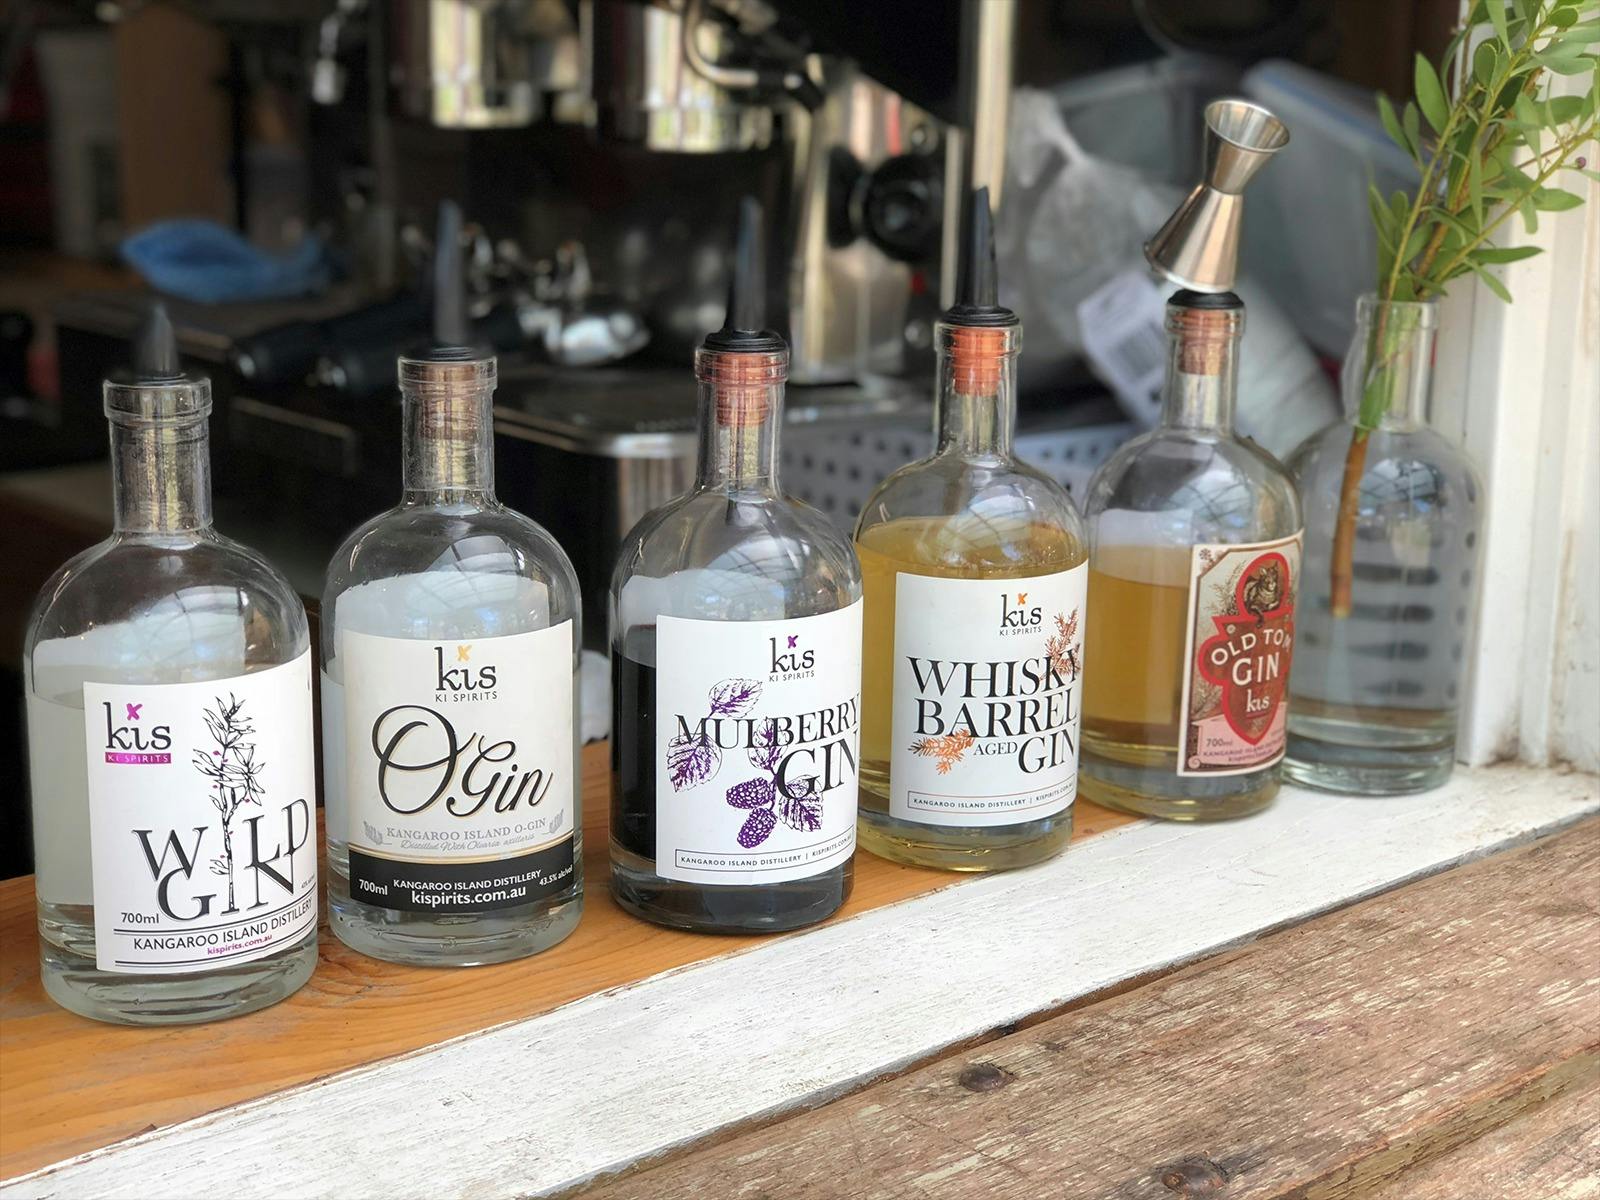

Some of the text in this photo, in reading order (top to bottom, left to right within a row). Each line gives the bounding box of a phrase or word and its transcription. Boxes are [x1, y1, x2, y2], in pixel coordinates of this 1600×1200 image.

[1001, 592, 1042, 628] kis
[1012, 626, 1042, 635] SPIRITS
[769, 635, 815, 673] kis
[1211, 633, 1257, 665] OLD
[434, 645, 497, 691] kis
[783, 671, 815, 682] SPIRITS
[906, 643, 1080, 698] WHISKY
[1232, 652, 1280, 686] GIN
[435, 691, 498, 702] KI SPIRITS
[914, 687, 1077, 738] BARREL
[1246, 689, 1270, 712] kis
[102, 701, 172, 751] kis
[674, 692, 860, 750] MULBERRY
[124, 754, 169, 763] SPIRITS
[973, 722, 1077, 774] AGED GIN
[776, 728, 859, 801] GIN
[914, 798, 956, 808] KANGAROO
[958, 799, 985, 808] ISLAND
[988, 798, 1026, 808] DISTILLERY
[387, 818, 546, 841] KANGAROO ISLAND O-GIN
[680, 856, 726, 867] KANGAROO
[728, 857, 758, 867] ISLAND
[760, 855, 802, 866] DISTILLERY
[157, 853, 297, 921] GIN
[358, 878, 388, 896] 700ml
[393, 879, 452, 891] KANGAROO
[454, 880, 491, 890] ISLAND
[494, 869, 542, 887] DISTILLERY
[411, 886, 526, 908] kispirits.com.au
[121, 911, 160, 925] 700ml
[133, 896, 313, 951] KANGAROO ISLAND DISTILLERY
[207, 934, 273, 956] kispirits.com.au
